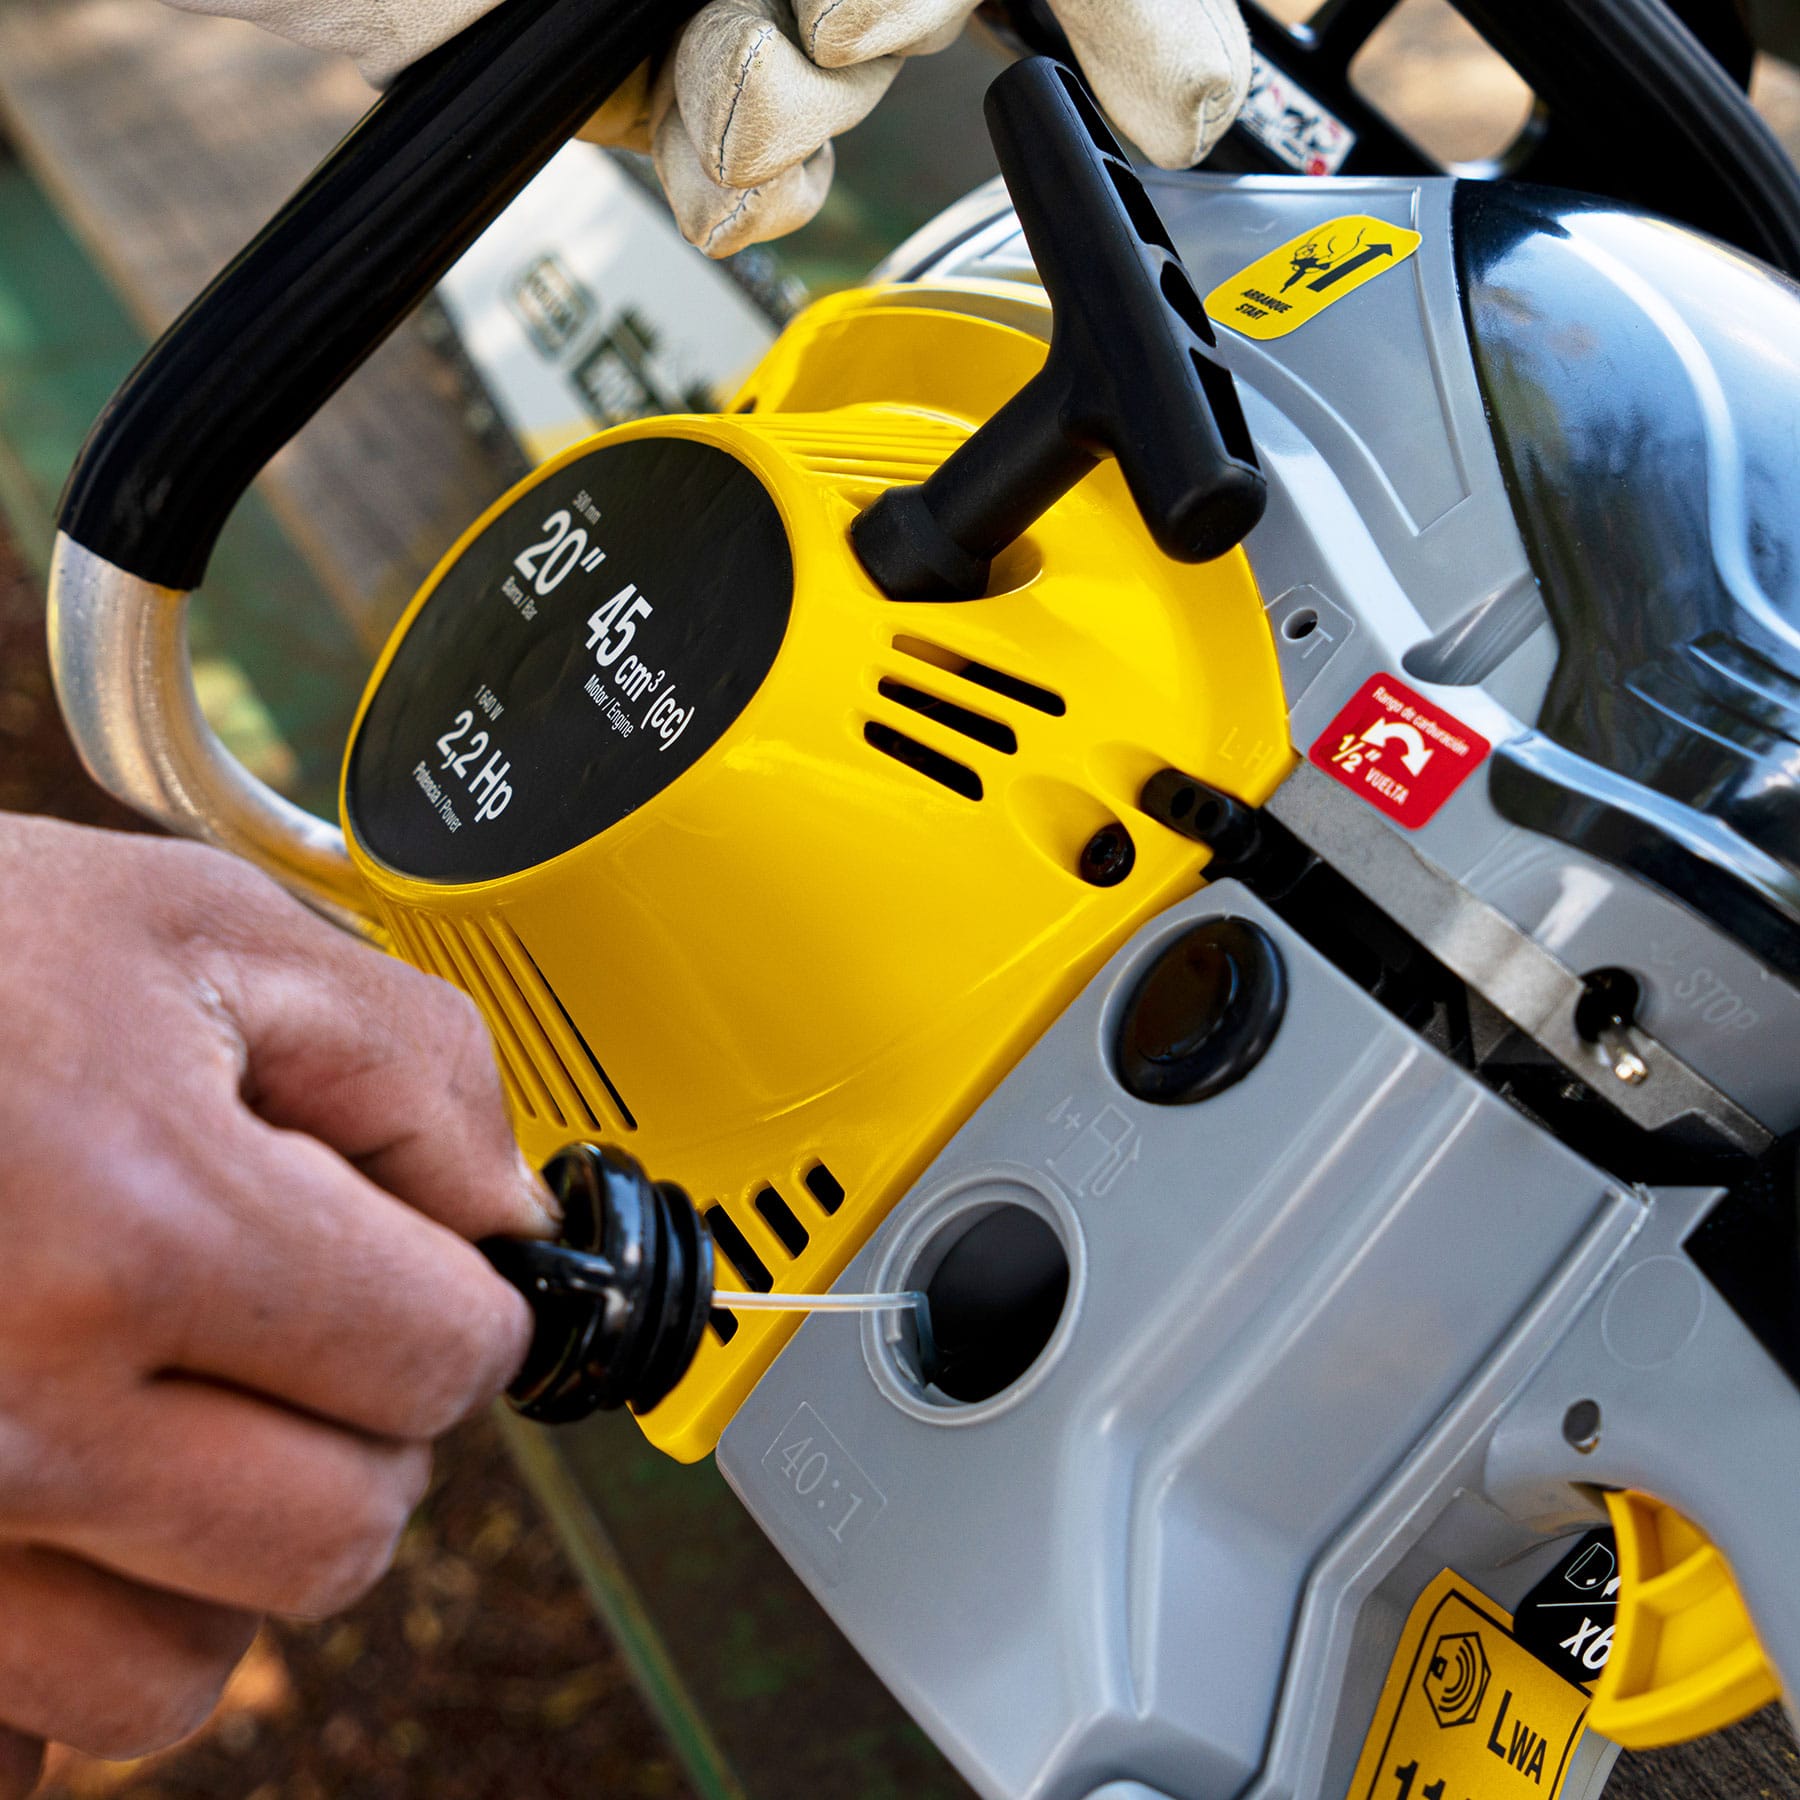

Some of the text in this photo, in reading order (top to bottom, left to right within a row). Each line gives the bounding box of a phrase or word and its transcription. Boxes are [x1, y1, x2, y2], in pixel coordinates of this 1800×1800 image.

[1235, 303, 1269, 320] START
[584, 504, 601, 525] mm
[501, 575, 524, 605] Barra
[521, 598, 538, 621] Bar
[585, 583, 654, 667] 45
[640, 684, 695, 752] (cc)
[489, 703, 504, 722] W
[583, 674, 609, 706] Motor
[606, 701, 634, 738] Engine
[1372, 686, 1404, 712] Rango
[1400, 707, 1417, 721] de
[436, 709, 513, 823] 2,2 Hp
[1364, 767, 1410, 805] VUELTA
[412, 760, 442, 804] Potencia
[438, 799, 462, 833] Power
[1674, 967, 1760, 1032] STOP
[780, 1436, 863, 1544] 40:1
